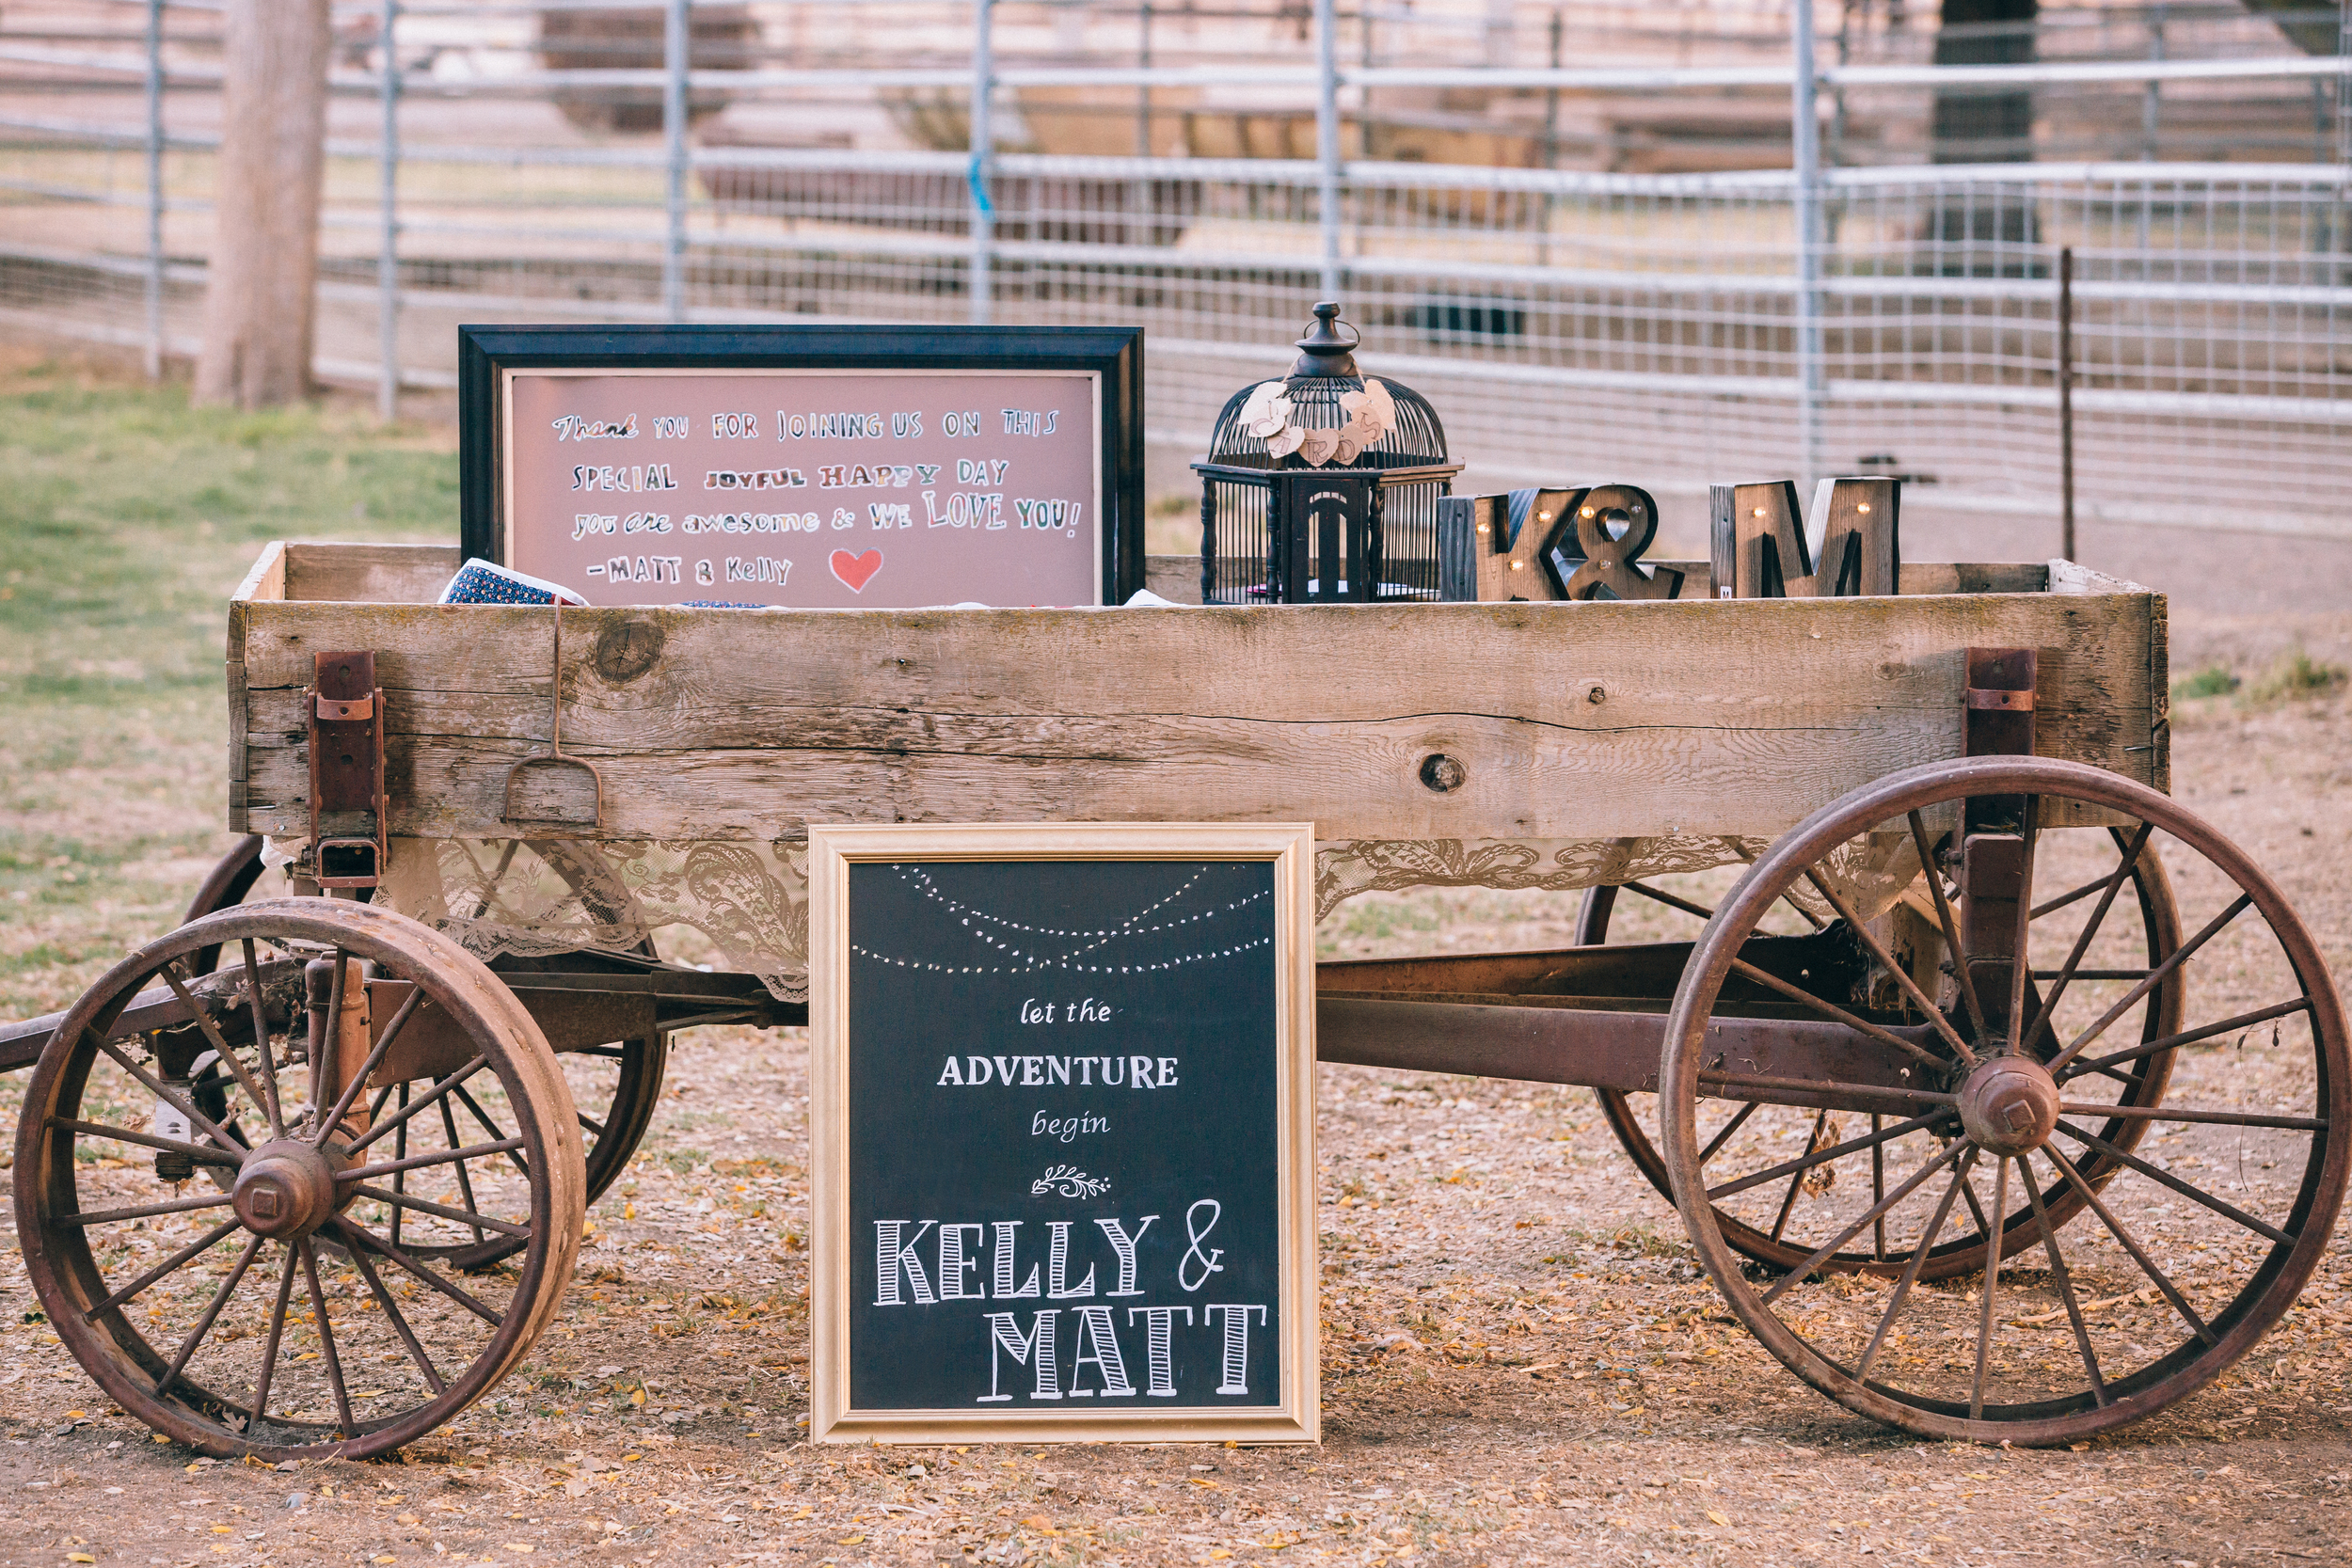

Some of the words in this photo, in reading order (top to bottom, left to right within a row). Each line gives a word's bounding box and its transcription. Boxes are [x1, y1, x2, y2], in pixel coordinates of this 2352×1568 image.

[552, 413, 639, 441] Thank
[653, 416, 689, 439] YOU
[712, 413, 758, 439] FOR
[777, 410, 883, 442] JOINING
[892, 411, 923, 438] US
[943, 411, 980, 437] ON
[1001, 409, 1059, 436] THIS
[572, 464, 677, 491] SPECIAL
[704, 468, 807, 491] JOYFUL
[819, 466, 941, 487] HAPPY
[958, 459, 1009, 485] DAY
[572, 514, 618, 541] you
[624, 512, 674, 534] are
[682, 513, 821, 534] awesome
[832, 508, 855, 530] &
[868, 503, 913, 530] WE
[922, 490, 1007, 530] LOVE
[1014, 499, 1081, 538] YOU!
[725, 557, 793, 585] Kelly
[1020, 998, 1055, 1025] let
[1067, 997, 1112, 1022] the
[937, 1054, 1179, 1089] ADVENTURE
[1031, 1110, 1111, 1143] begin
[873, 1215, 1160, 1306] KELLY
[1179, 1198, 1224, 1291] &
[977, 1305, 1266, 1402] MATT
